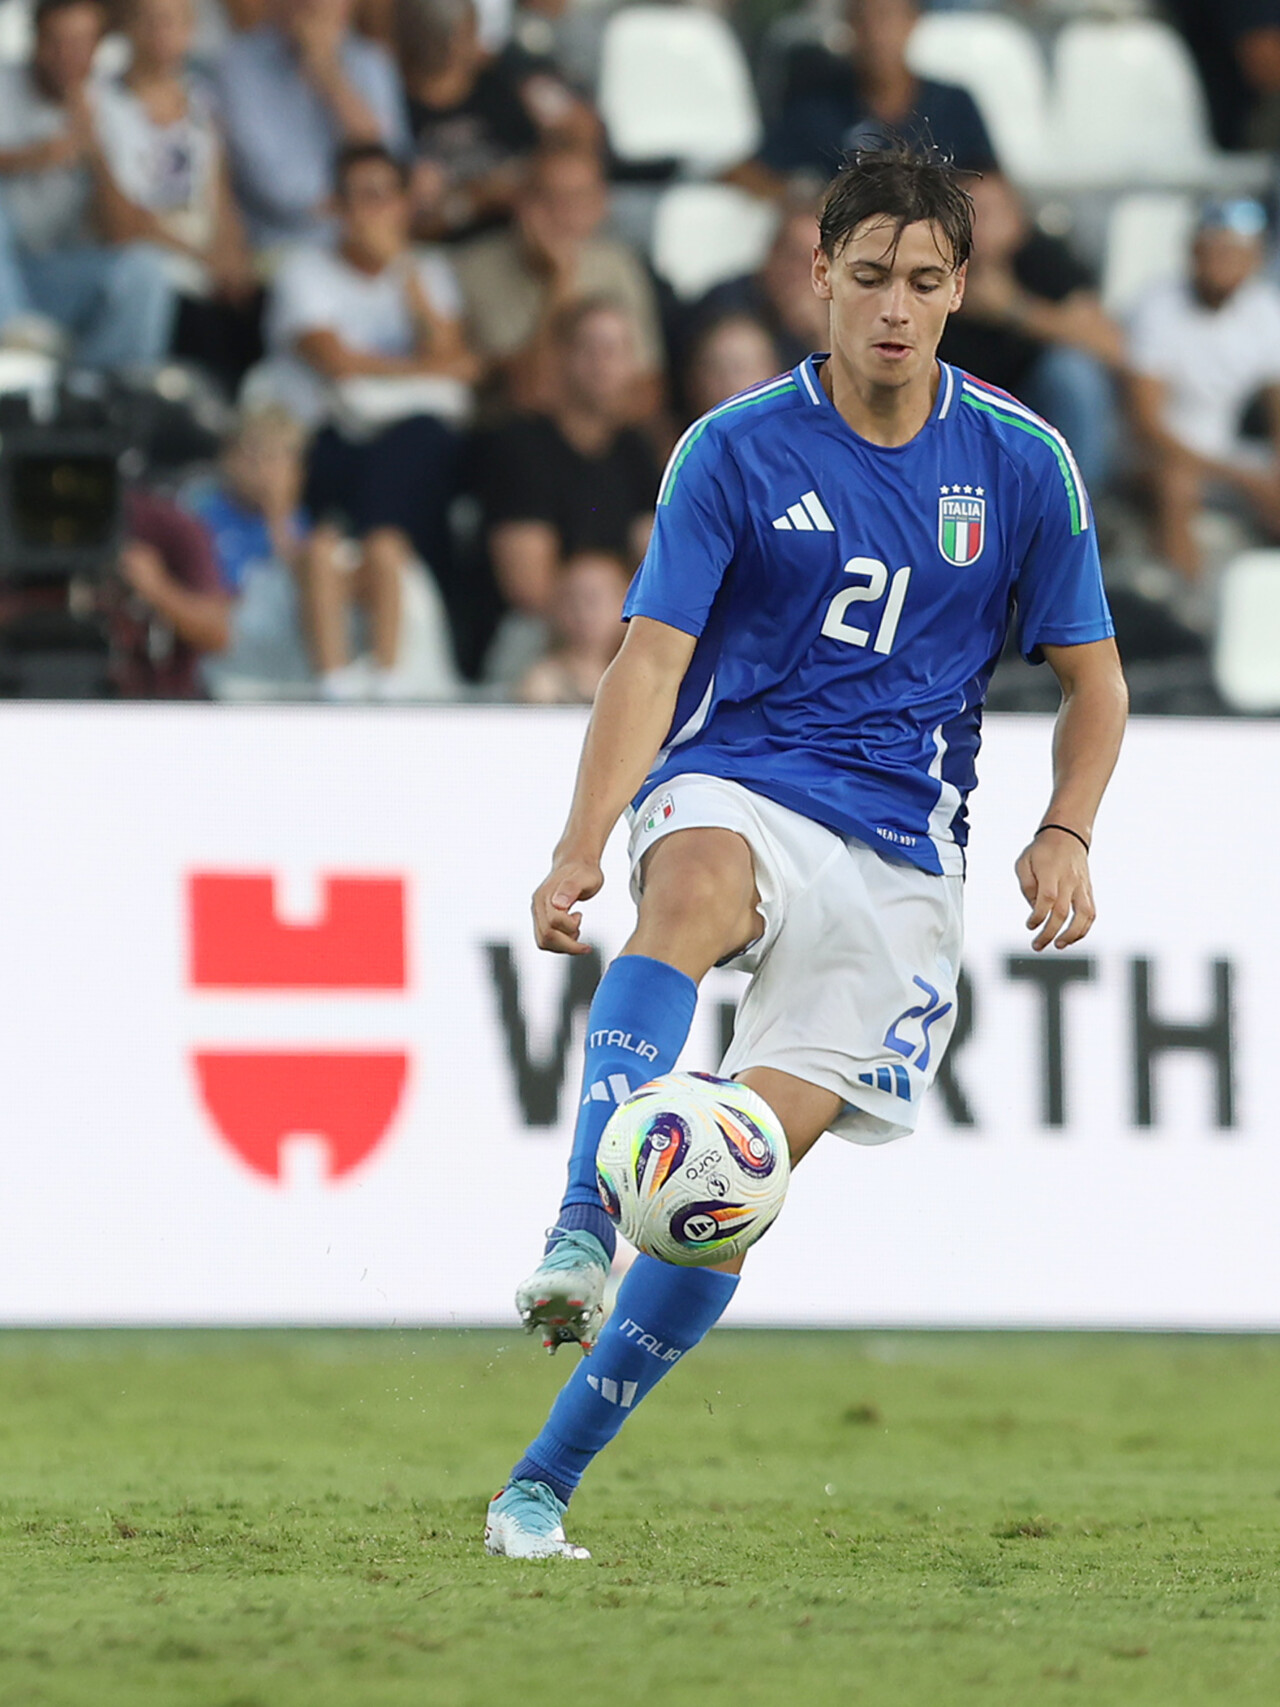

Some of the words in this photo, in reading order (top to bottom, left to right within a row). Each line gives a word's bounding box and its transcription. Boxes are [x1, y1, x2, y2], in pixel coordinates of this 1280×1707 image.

[943, 501, 980, 516] ITALIA
[821, 556, 911, 655] 21
[883, 974, 952, 1072] 21
[591, 1029, 658, 1062] ITALIA
[619, 1318, 681, 1361] ITALIA
